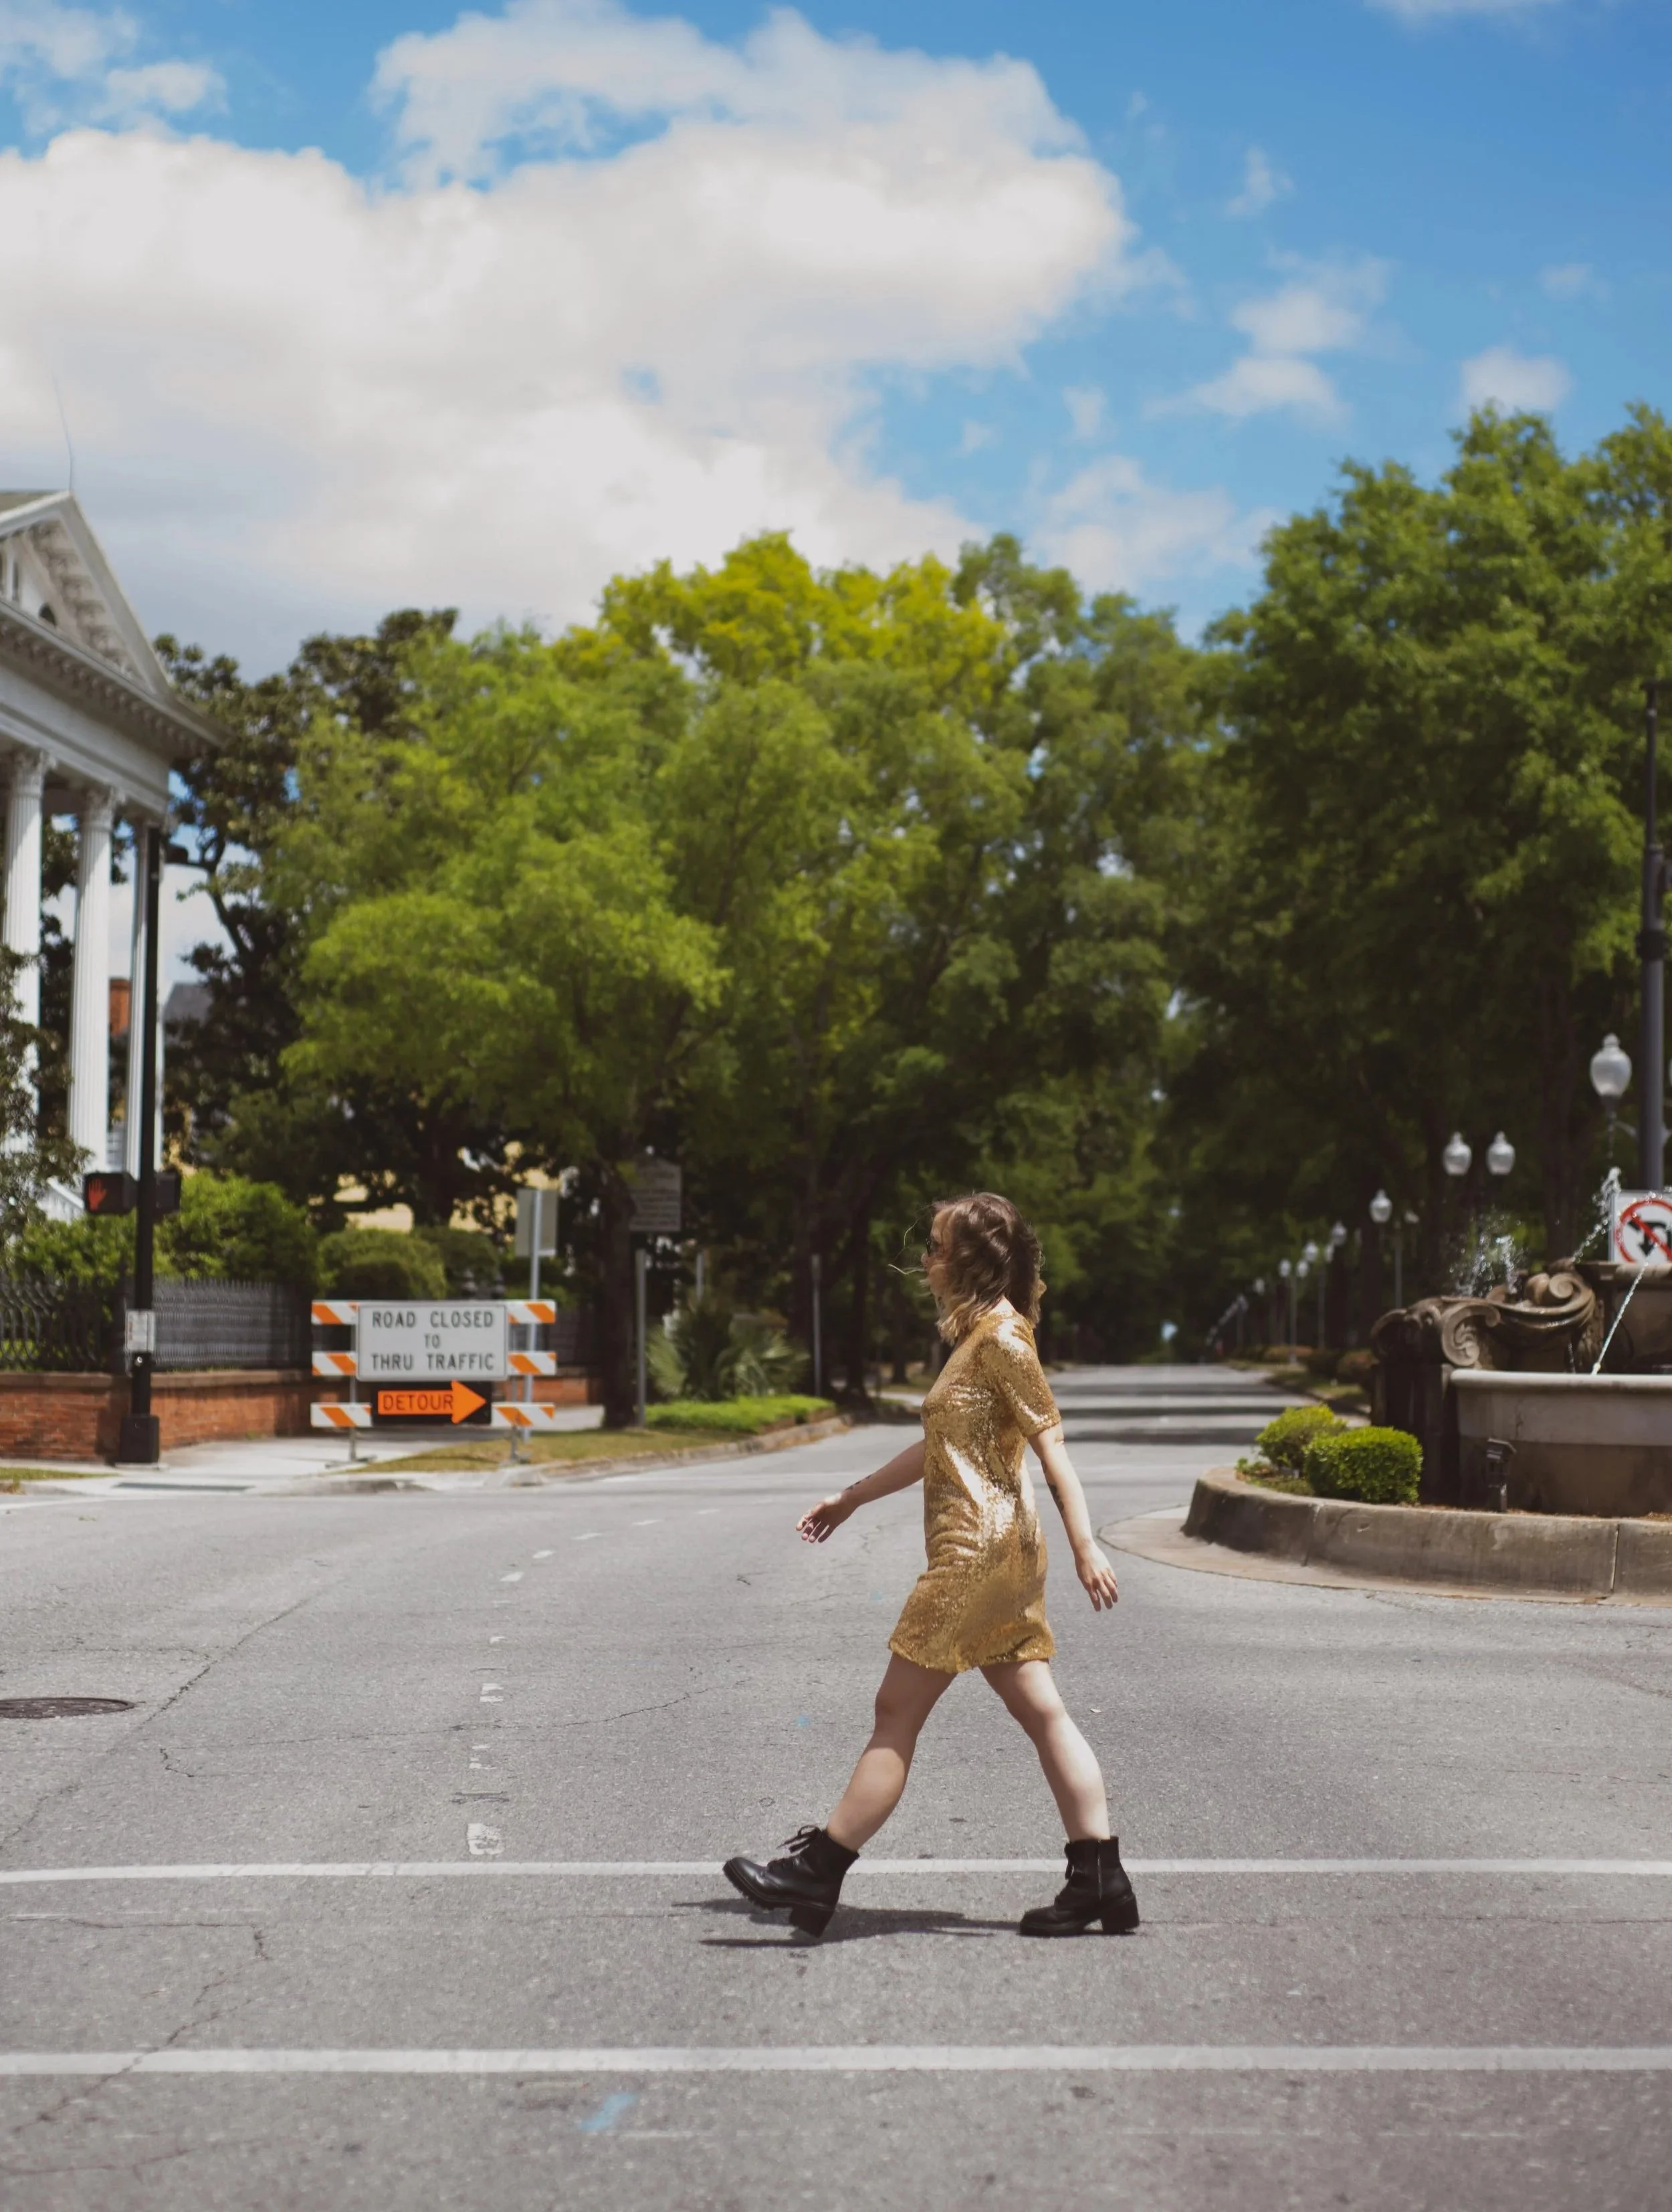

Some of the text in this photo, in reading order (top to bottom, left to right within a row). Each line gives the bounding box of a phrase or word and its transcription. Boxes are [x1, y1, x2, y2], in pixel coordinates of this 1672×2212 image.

[372, 1311, 494, 1328] ROAD CLOSED
[424, 1333, 441, 1349] TO
[371, 1353, 494, 1371] THRU TRAFFIC
[383, 1394, 453, 1410] DETOUR
